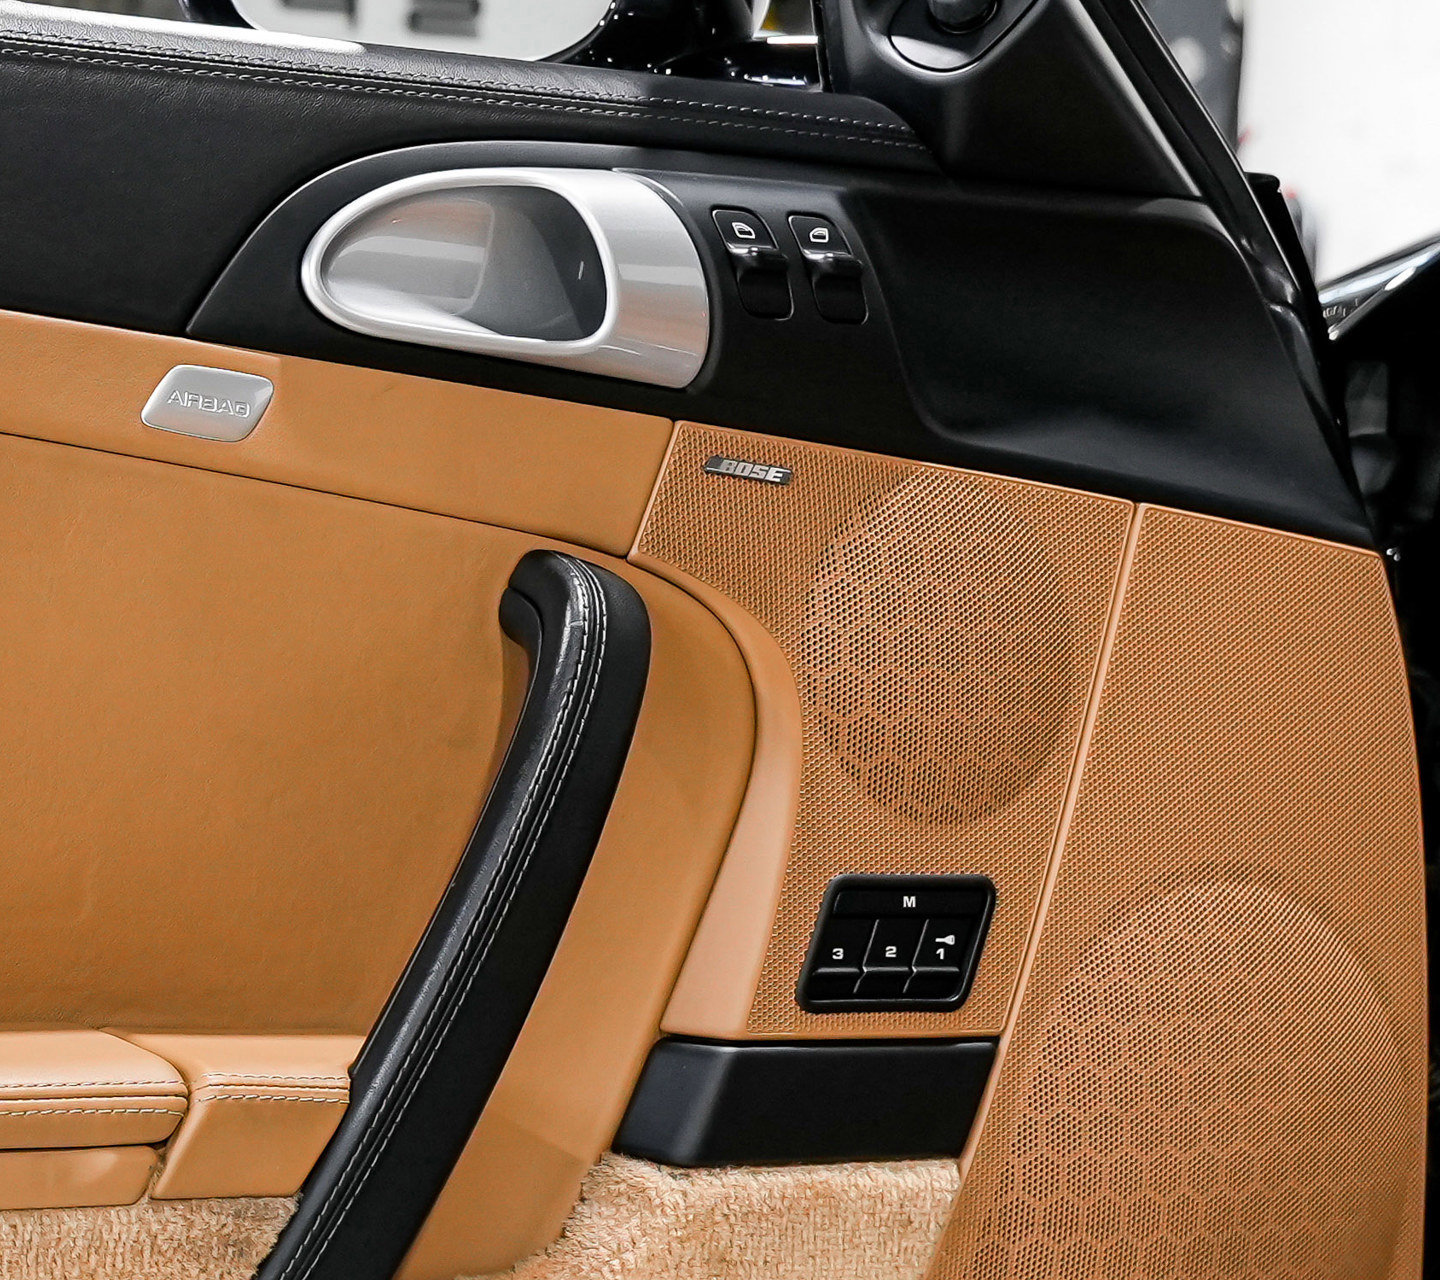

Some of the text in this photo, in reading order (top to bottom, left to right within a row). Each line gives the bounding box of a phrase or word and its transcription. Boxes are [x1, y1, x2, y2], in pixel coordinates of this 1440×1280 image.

[166, 389, 252, 419] AIRBAG
[718, 459, 791, 483] BOSE
[902, 895, 917, 908] M
[831, 945, 945, 960] 3 2 1
